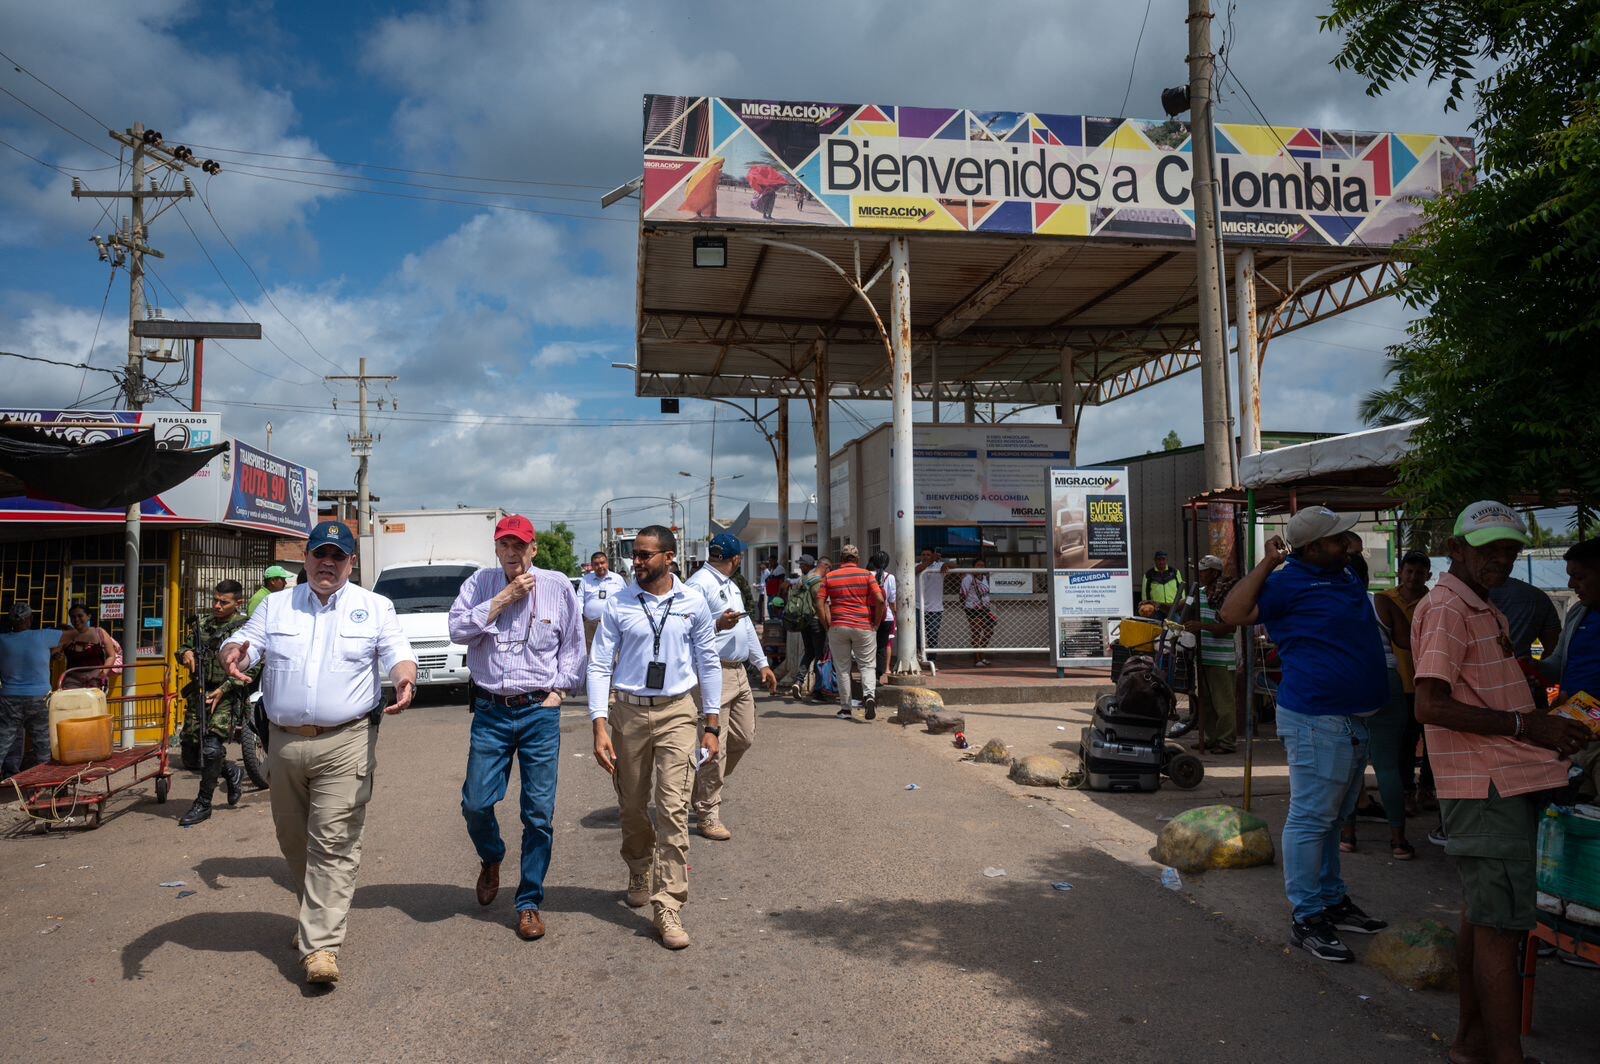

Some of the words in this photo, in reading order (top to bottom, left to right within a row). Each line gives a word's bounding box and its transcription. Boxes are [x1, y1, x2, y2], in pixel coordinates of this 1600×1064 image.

[741, 102, 831, 119] MIGRACIÓN
[827, 138, 1101, 201] Bienvenidos
[1112, 165, 1139, 203] a
[1156, 155, 1370, 213] Clombia
[859, 205, 927, 217] MIGRACIÓN
[1222, 220, 1299, 234] MIGRACIÓN
[194, 431, 209, 442] JP
[239, 448, 265, 471] TRANSPORTE
[240, 463, 269, 498] RUTA
[271, 476, 286, 503] 90
[1054, 476, 1112, 486] MIGRACIÓN
[988, 494, 1030, 502] COLOMBIA
[1011, 507, 1046, 516] MIGRAC
[1089, 500, 1123, 514] EVÍTESE
[1090, 513, 1124, 523] SANCIONES
[103, 586, 127, 594] SIGA
